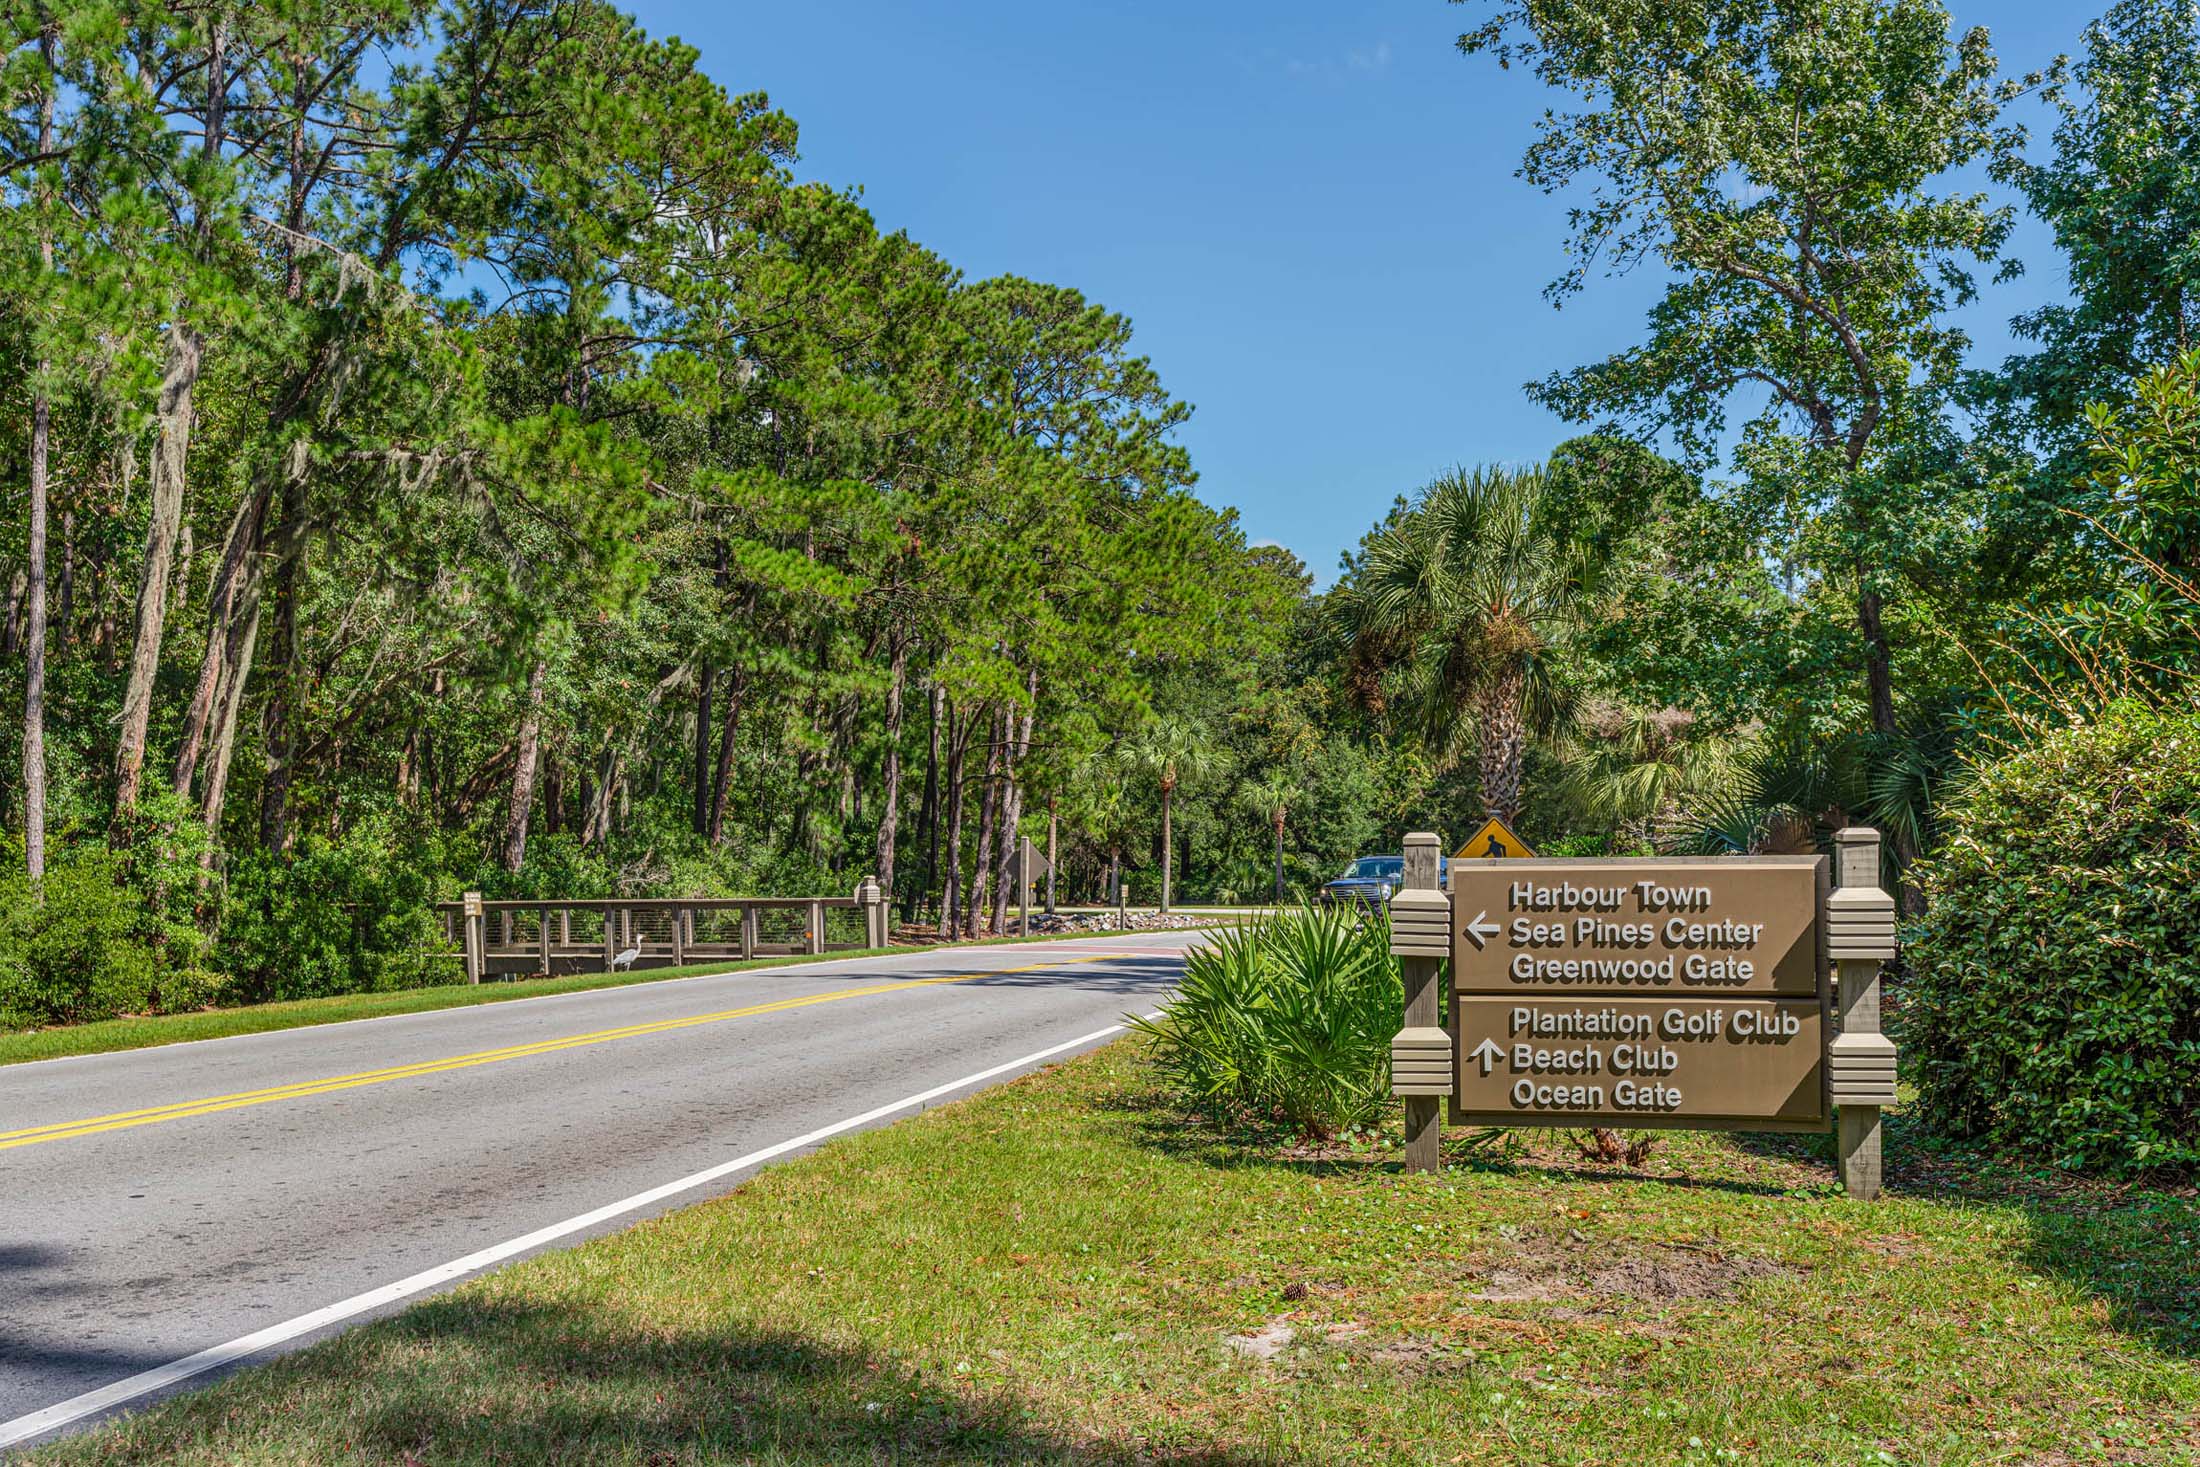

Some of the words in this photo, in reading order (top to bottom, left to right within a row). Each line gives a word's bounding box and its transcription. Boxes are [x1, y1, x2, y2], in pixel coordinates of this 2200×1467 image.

[1513, 881, 1627, 906] Harbour
[1637, 881, 1711, 906] Town
[1513, 918, 1565, 943] Sea
[1577, 918, 1655, 943] Pines
[1665, 918, 1763, 944] Center
[1513, 954, 1674, 979] Greenwood
[1685, 955, 1754, 980] Gate
[1514, 1008, 1652, 1034] Plantation
[1663, 1009, 1722, 1035] Golf
[1732, 1011, 1800, 1036] Club
[1514, 1044, 1601, 1069] Beach
[1612, 1044, 1678, 1070] Club
[1514, 1079, 1602, 1105] Ocean
[1615, 1080, 1682, 1107] Gate
